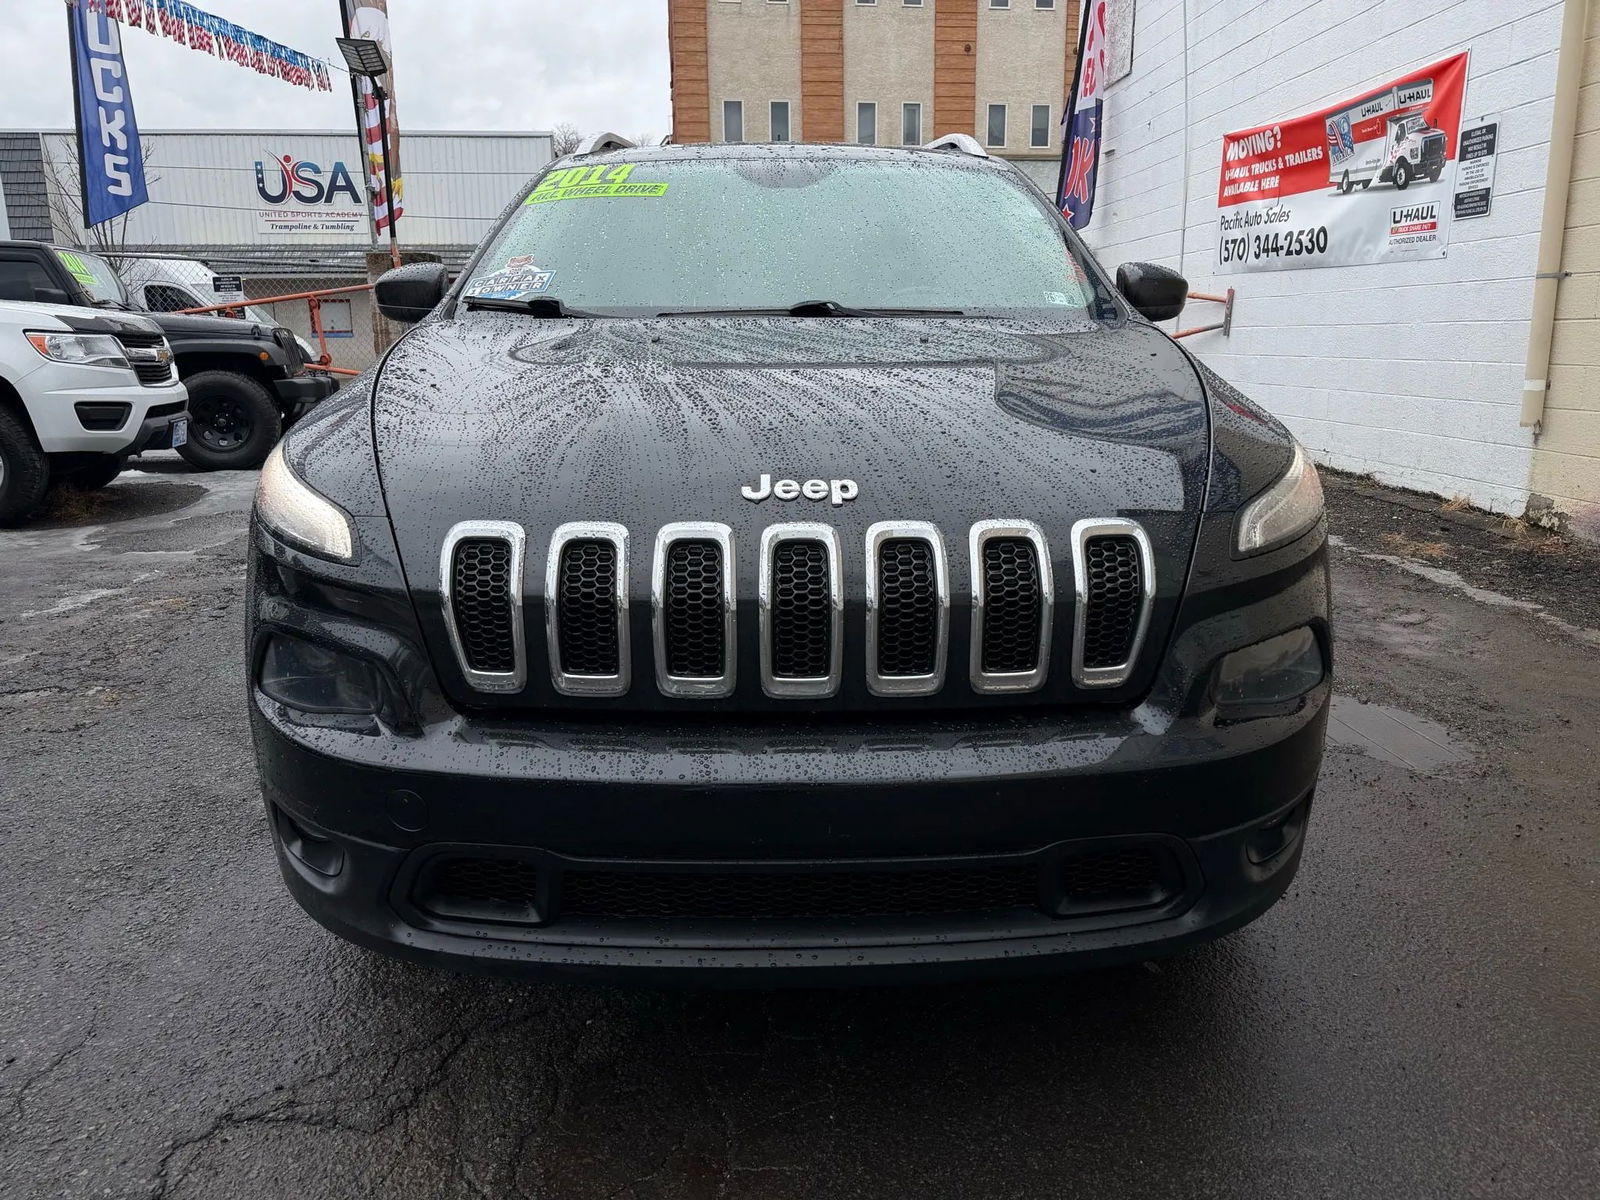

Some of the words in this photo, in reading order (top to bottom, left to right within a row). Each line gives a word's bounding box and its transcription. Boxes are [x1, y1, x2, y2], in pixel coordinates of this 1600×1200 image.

[1398, 88, 1432, 104] U-HAUL
[1360, 103, 1384, 117] U-HAUL
[1226, 125, 1281, 162] MOVING?
[1225, 165, 1249, 181] U-HAUL
[1251, 158, 1277, 175] TRUCKS
[1278, 157, 1284, 169] &
[1285, 146, 1323, 167] TRAILERS
[255, 160, 362, 204] USA
[534, 163, 636, 193] 2014
[1223, 180, 1259, 197] AVAILABLE
[1261, 175, 1280, 191] HERE
[533, 192, 559, 202] ALL
[561, 185, 610, 198] WHEEL
[613, 184, 662, 194] DRIVE
[291, 210, 323, 218] SPORTS
[1220, 210, 1243, 231] Pacific
[1244, 209, 1262, 228] Auto
[1264, 204, 1291, 224] Sales
[1392, 205, 1437, 224] U-HAUL
[270, 223, 312, 232] Trampoline
[320, 223, 355, 232] Tumbling
[1219, 232, 1250, 266] (570)
[1254, 225, 1328, 260] 344-2530
[1416, 234, 1437, 243] DEALER
[475, 274, 547, 287] CARFAX
[481, 283, 543, 294] OWNER
[741, 474, 859, 505] Jeep
